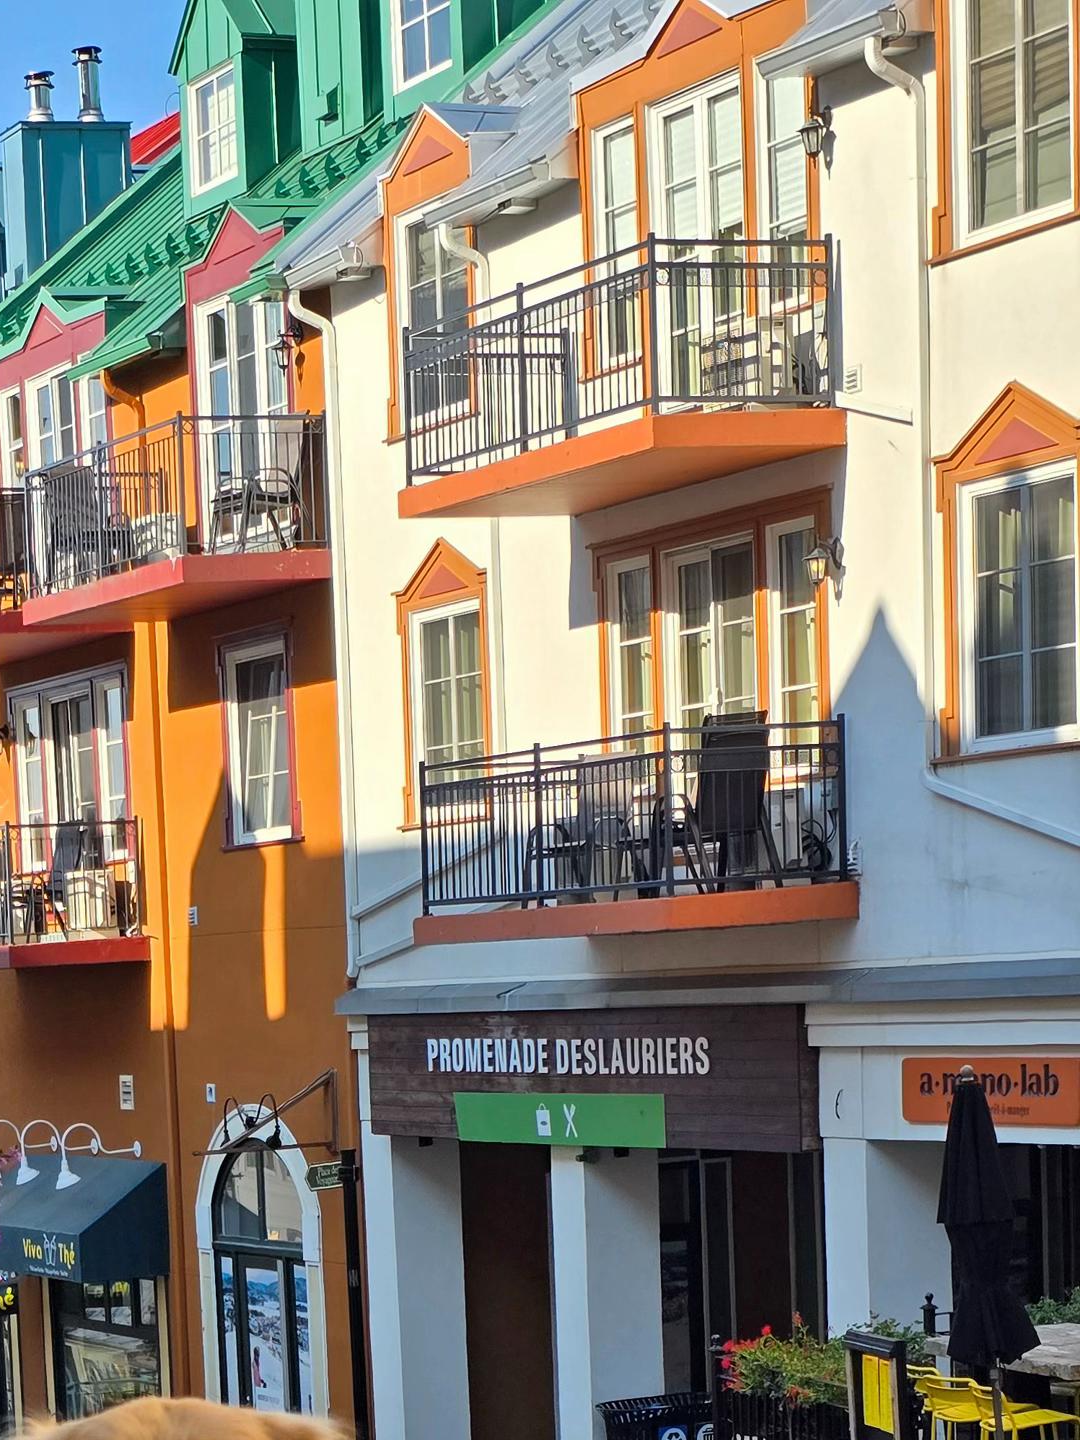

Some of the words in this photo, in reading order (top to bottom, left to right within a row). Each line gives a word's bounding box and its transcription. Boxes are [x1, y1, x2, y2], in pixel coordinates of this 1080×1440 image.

[427, 1038, 548, 1074] PROMENADE
[556, 1037, 710, 1075] DESLAURIERS
[22, 1238, 42, 1259] Viva
[58, 1242, 75, 1269] Thé
